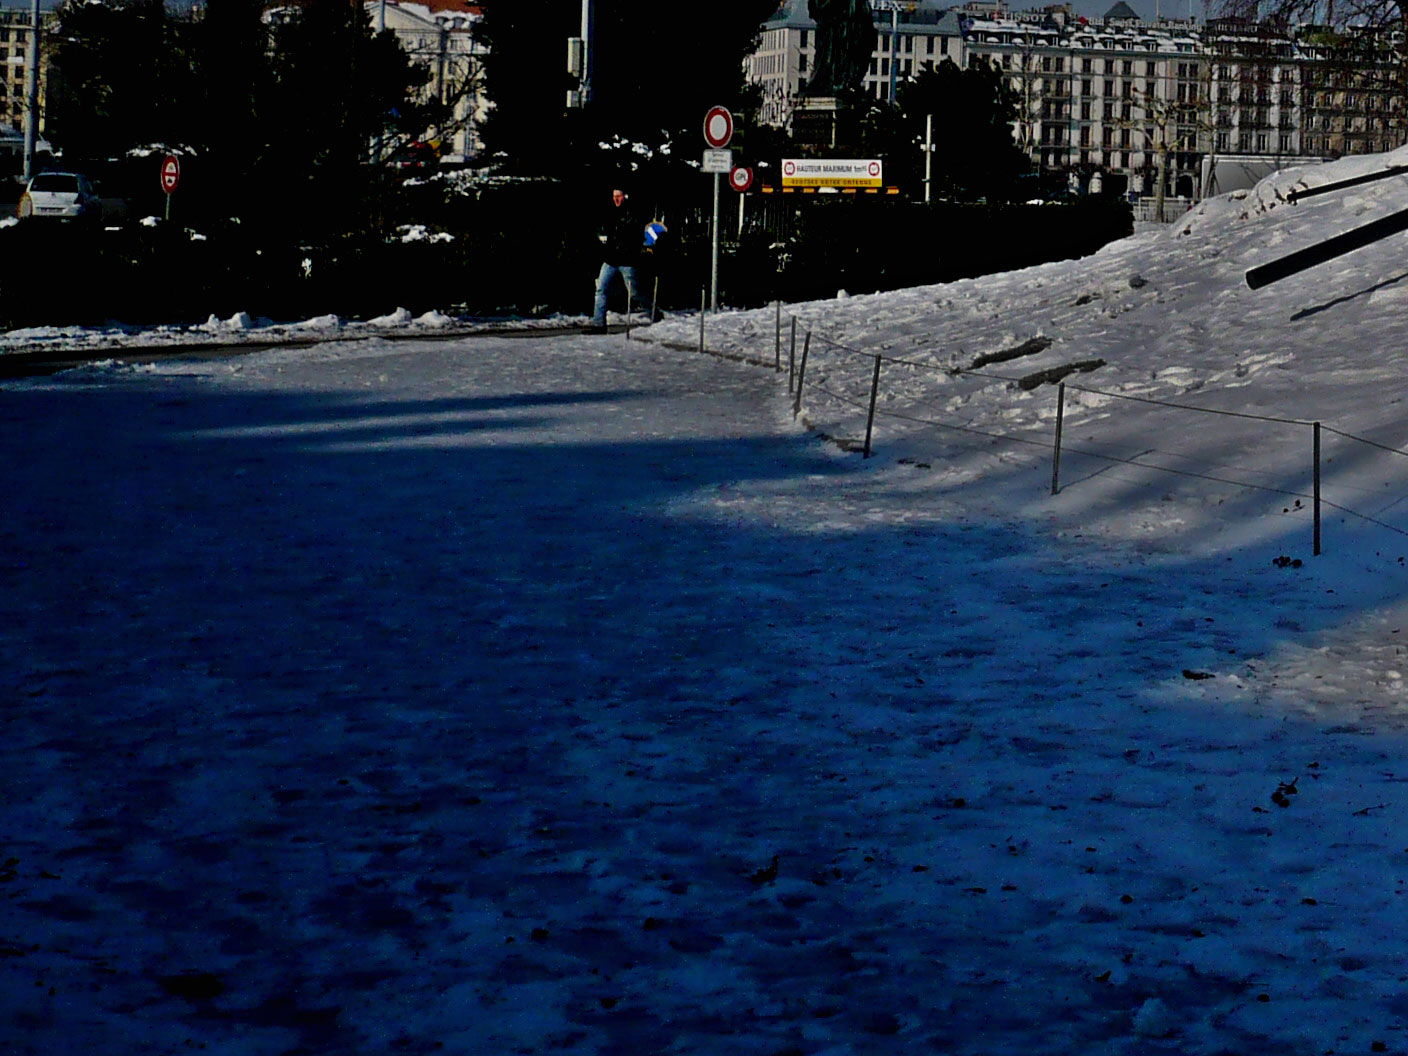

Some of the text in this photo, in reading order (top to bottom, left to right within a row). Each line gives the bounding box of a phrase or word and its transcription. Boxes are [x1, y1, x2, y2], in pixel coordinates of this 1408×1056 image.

[1004, 12, 1047, 23] TISSOT
[796, 165, 821, 174] HAUTEUR
[822, 165, 852, 174] MAXIMUM
